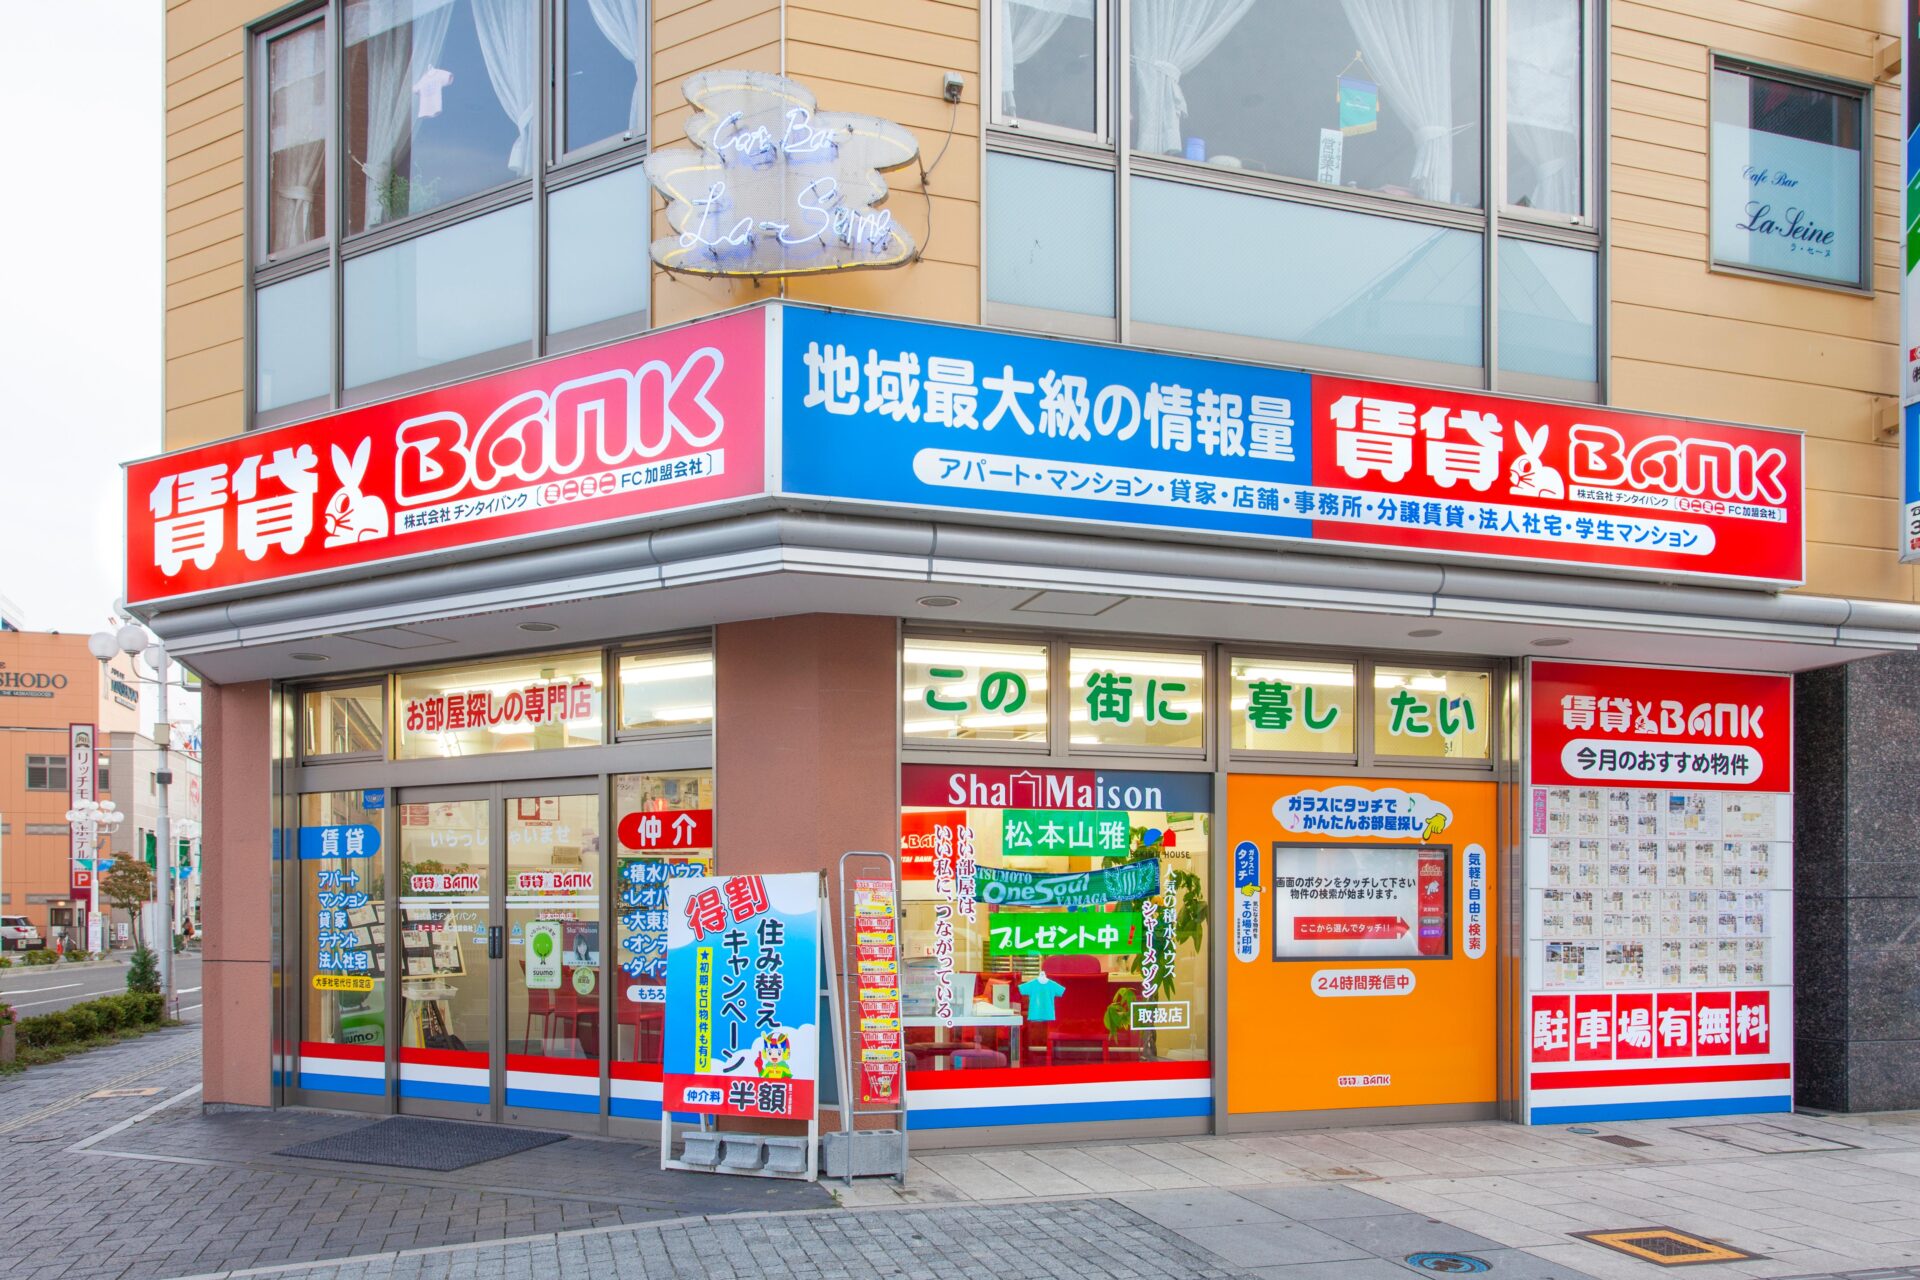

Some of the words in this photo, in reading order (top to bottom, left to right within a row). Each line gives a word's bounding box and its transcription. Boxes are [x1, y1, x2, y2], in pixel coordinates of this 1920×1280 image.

[1742, 165, 1768, 186] Cafe
[1771, 170, 1798, 188] Bar
[804, 341, 1294, 462] 地域最大級の情報量
[149, 443, 318, 577] 賃貸
[395, 346, 724, 506] BANK
[1330, 395, 1503, 492] 賃貸
[1569, 423, 1787, 505] BANK
[406, 681, 592, 731] お部屋探しの専門店
[926, 668, 1027, 714] この
[1087, 671, 1189, 723] 街に
[1248, 681, 1338, 731] 暮し
[1391, 690, 1474, 735] たい
[1561, 695, 1632, 733] 賃貸
[1660, 700, 1763, 739] BANK
[1577, 747, 1749, 776] 今月のおすすめ物件
[76, 753, 91, 859] リッチモホテル
[949, 773, 1006, 806] Sha
[1046, 775, 1162, 809] Maison
[1289, 797, 1397, 813] ガラスにタッチで
[638, 814, 697, 847] 仲介
[1005, 819, 1126, 850] 松本山雅
[1303, 815, 1423, 832] かんたんお部屋探し
[321, 828, 364, 856] 賃貸
[1164, 850, 1191, 859] HOUSE
[77, 873, 89, 885] P
[318, 871, 359, 888] アパート
[957, 825, 976, 924] いい部屋は、
[1238, 849, 1248, 881] タッチ
[443, 876, 478, 889] BANK
[553, 874, 592, 888] BANK
[1276, 876, 1416, 888] 画面のボタンをタッチして下さい
[1290, 888, 1398, 900] 物件の検索が始まります。
[318, 892, 368, 908] マンション
[1468, 853, 1481, 950] 気軽に自由に検索
[319, 912, 347, 929] 貸家
[934, 825, 954, 1029] いい私に、つながっている。
[1163, 864, 1177, 979] 人気の積水ハウス
[318, 933, 358, 948] テナント
[1142, 901, 1158, 998] シャーメゾン
[319, 952, 368, 970] 法人社宅
[755, 918, 784, 1029] 住み替え
[1317, 974, 1410, 991] 24時間発信中
[721, 929, 749, 1073] キャンペーン
[1138, 1007, 1182, 1024] 取扱店
[1533, 1004, 1769, 1051] 駐車場有無料
[686, 1090, 721, 1103] 仲介料
[729, 1081, 786, 1114] 半額
